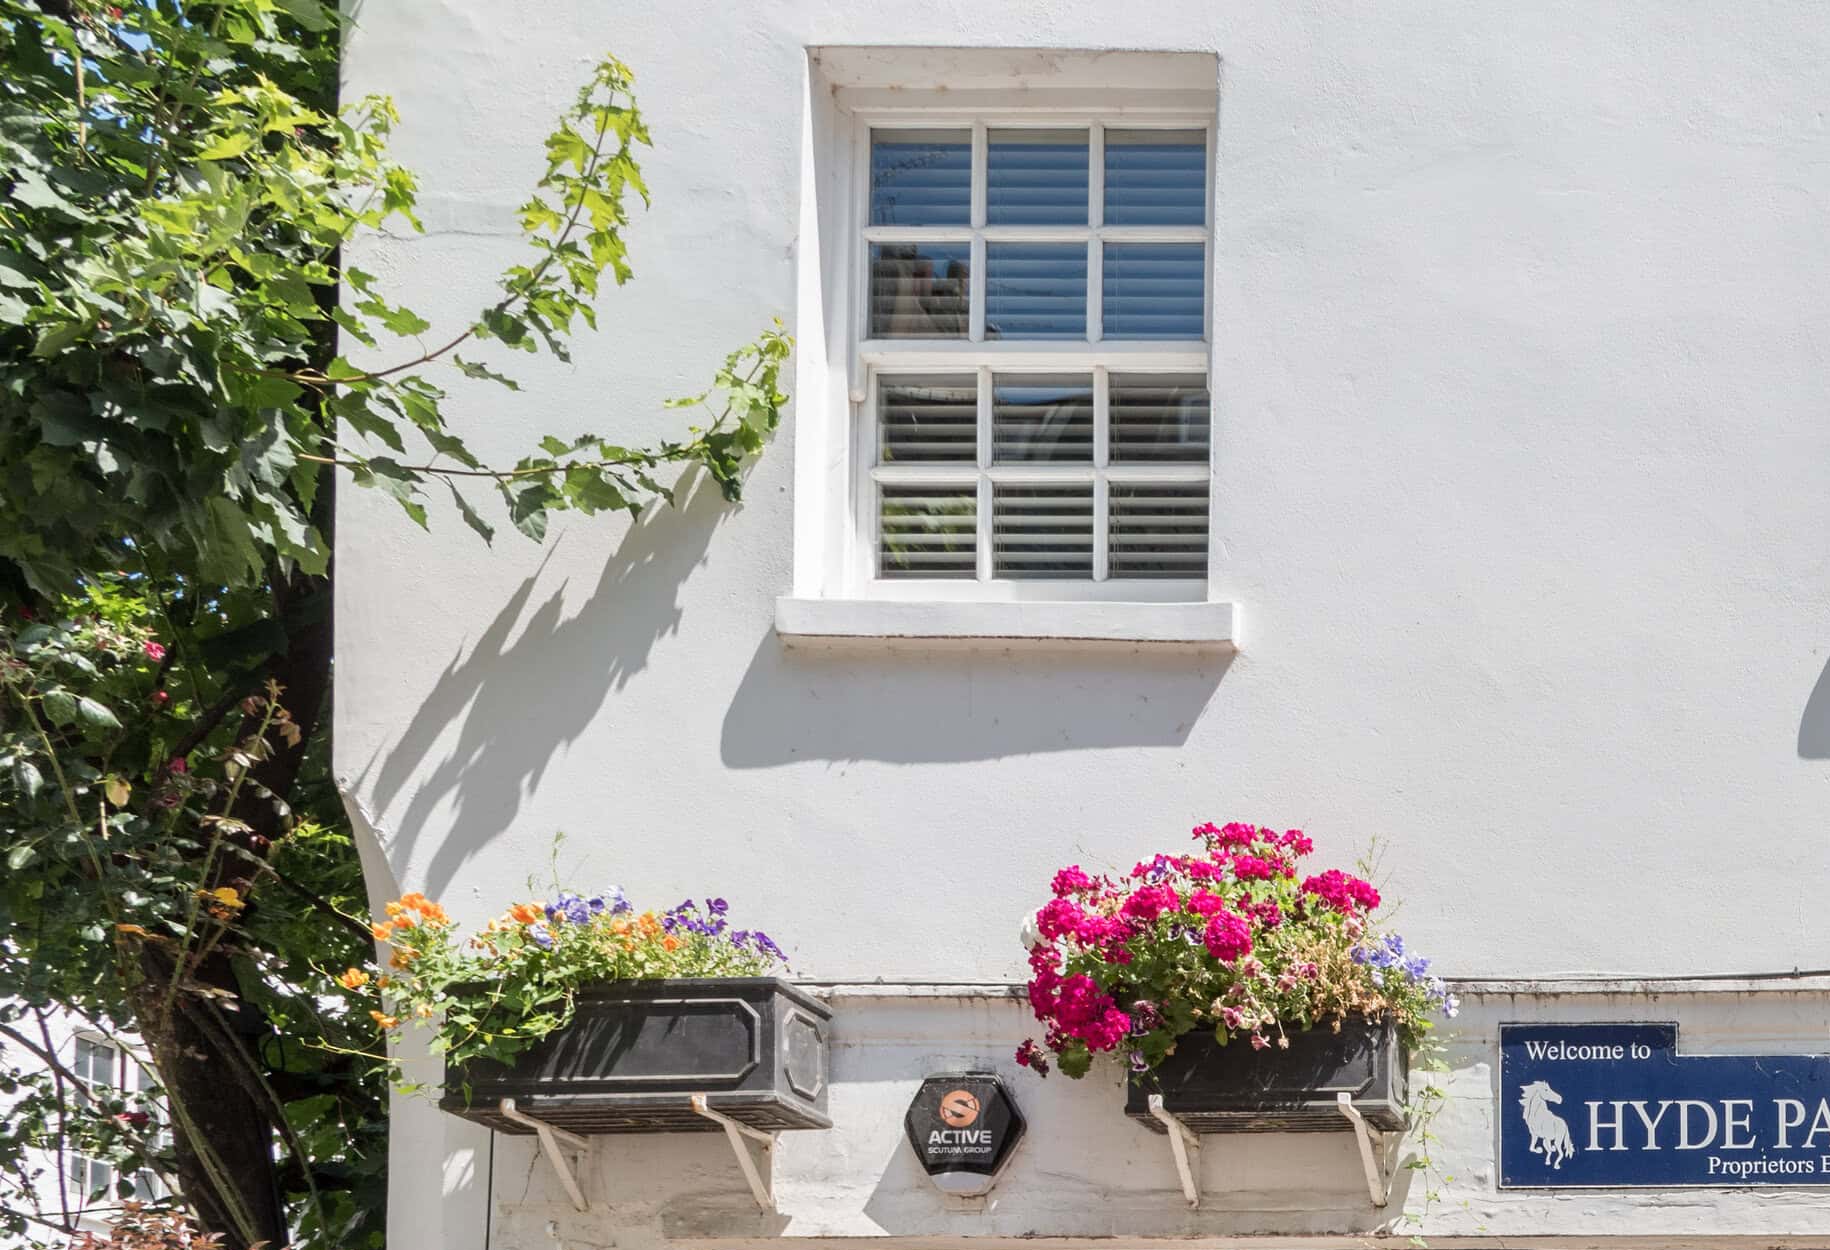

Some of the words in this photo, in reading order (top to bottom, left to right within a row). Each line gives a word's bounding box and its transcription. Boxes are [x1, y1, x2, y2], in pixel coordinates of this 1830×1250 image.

[1525, 1040, 1624, 1061] Welcome
[1631, 1042, 1652, 1060] to
[1584, 1099, 1757, 1152] HYDE
[928, 1130, 992, 1144] ACTIVE
[928, 1146, 962, 1154] SCUTUM
[963, 1146, 992, 1154] GROUP
[1707, 1155, 1816, 1178] Proprietors
